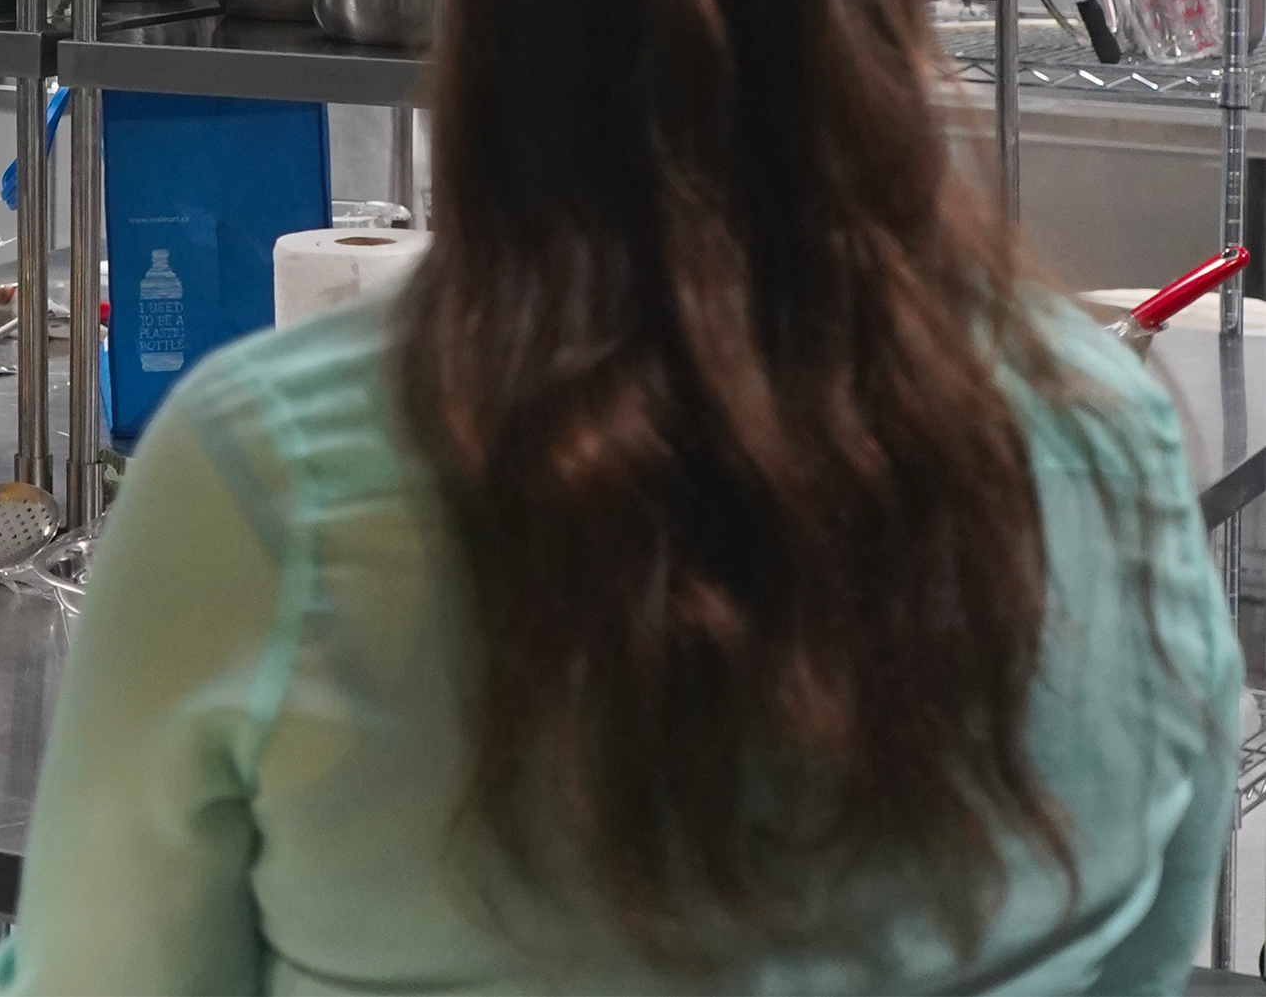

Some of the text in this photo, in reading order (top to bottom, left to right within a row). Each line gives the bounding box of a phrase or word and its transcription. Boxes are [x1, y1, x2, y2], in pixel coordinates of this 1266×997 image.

[150, 301, 184, 313] USED
[139, 314, 184, 326] TO BE A
[139, 327, 185, 339] PLASTIC
[139, 339, 185, 351] BOTTLE
